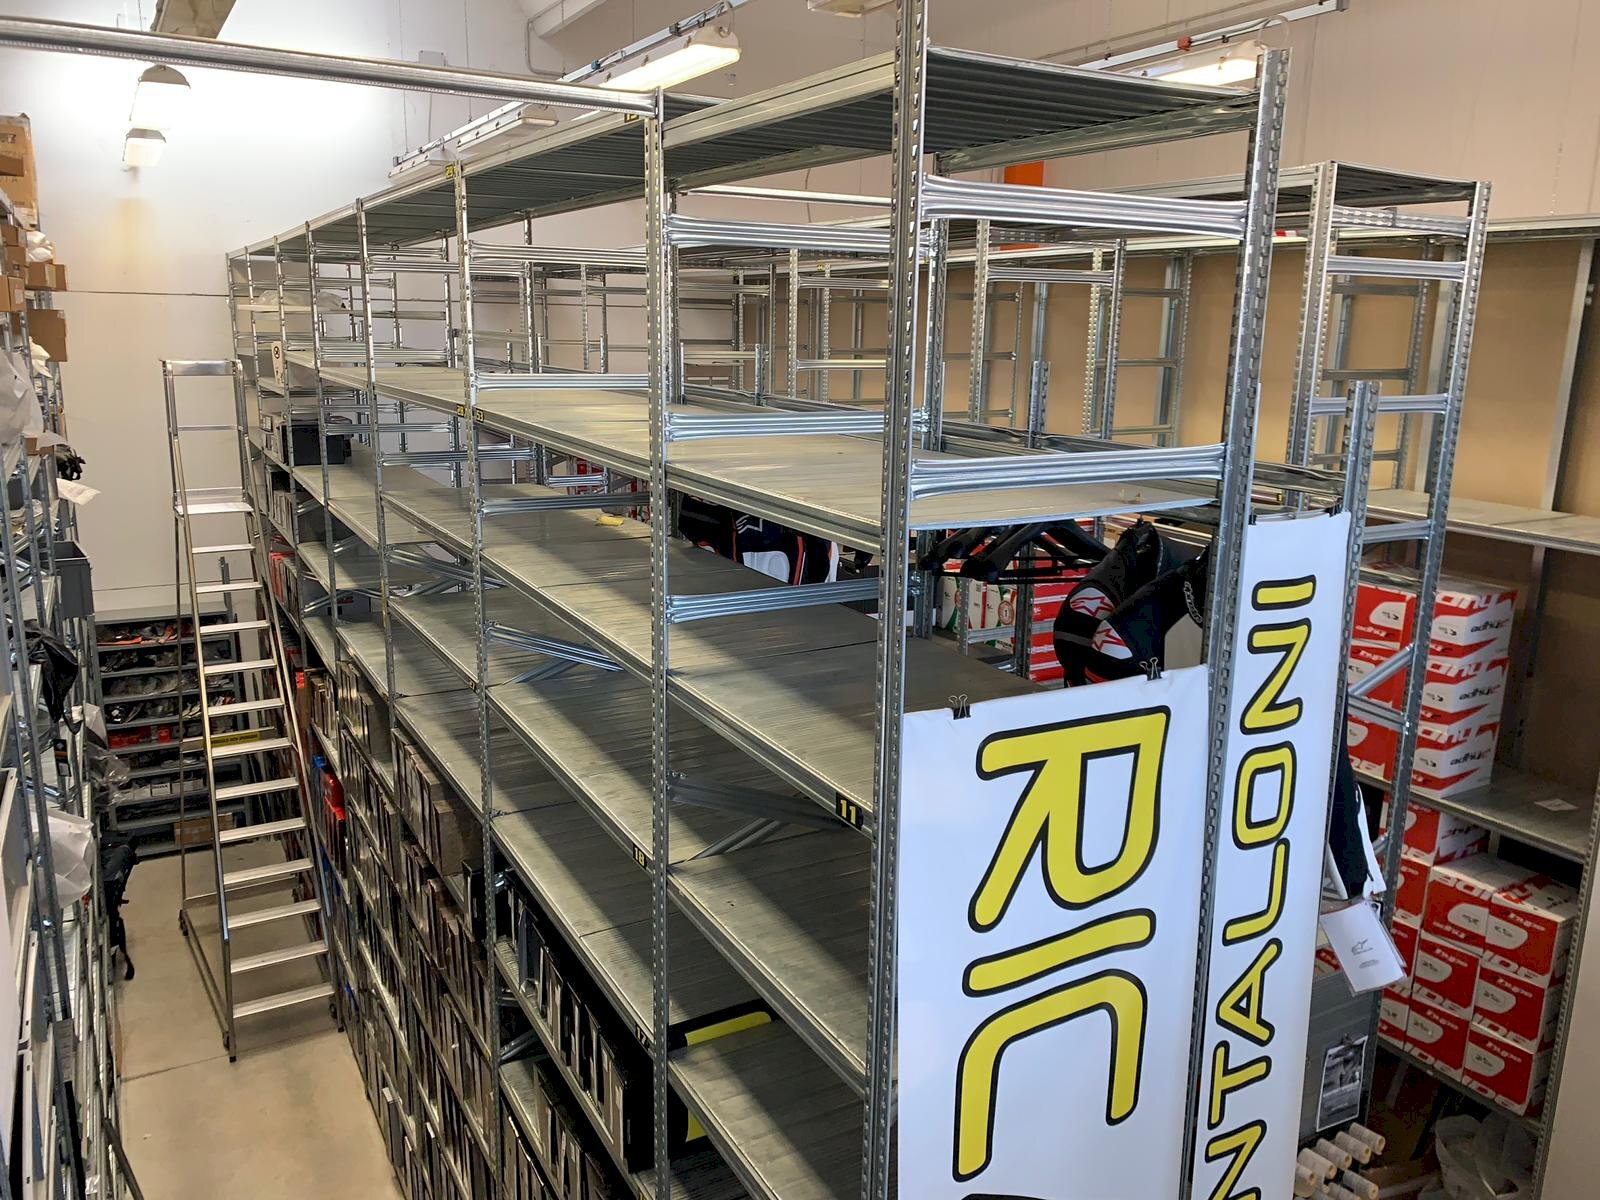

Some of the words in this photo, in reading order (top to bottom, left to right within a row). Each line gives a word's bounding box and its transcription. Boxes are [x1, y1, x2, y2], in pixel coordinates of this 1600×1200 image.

[476, 409, 484, 423] 53
[840, 799, 856, 825] 11
[634, 844, 645, 867] 18
[950, 705, 1172, 1200] RIC
[636, 1026, 647, 1045] 17
